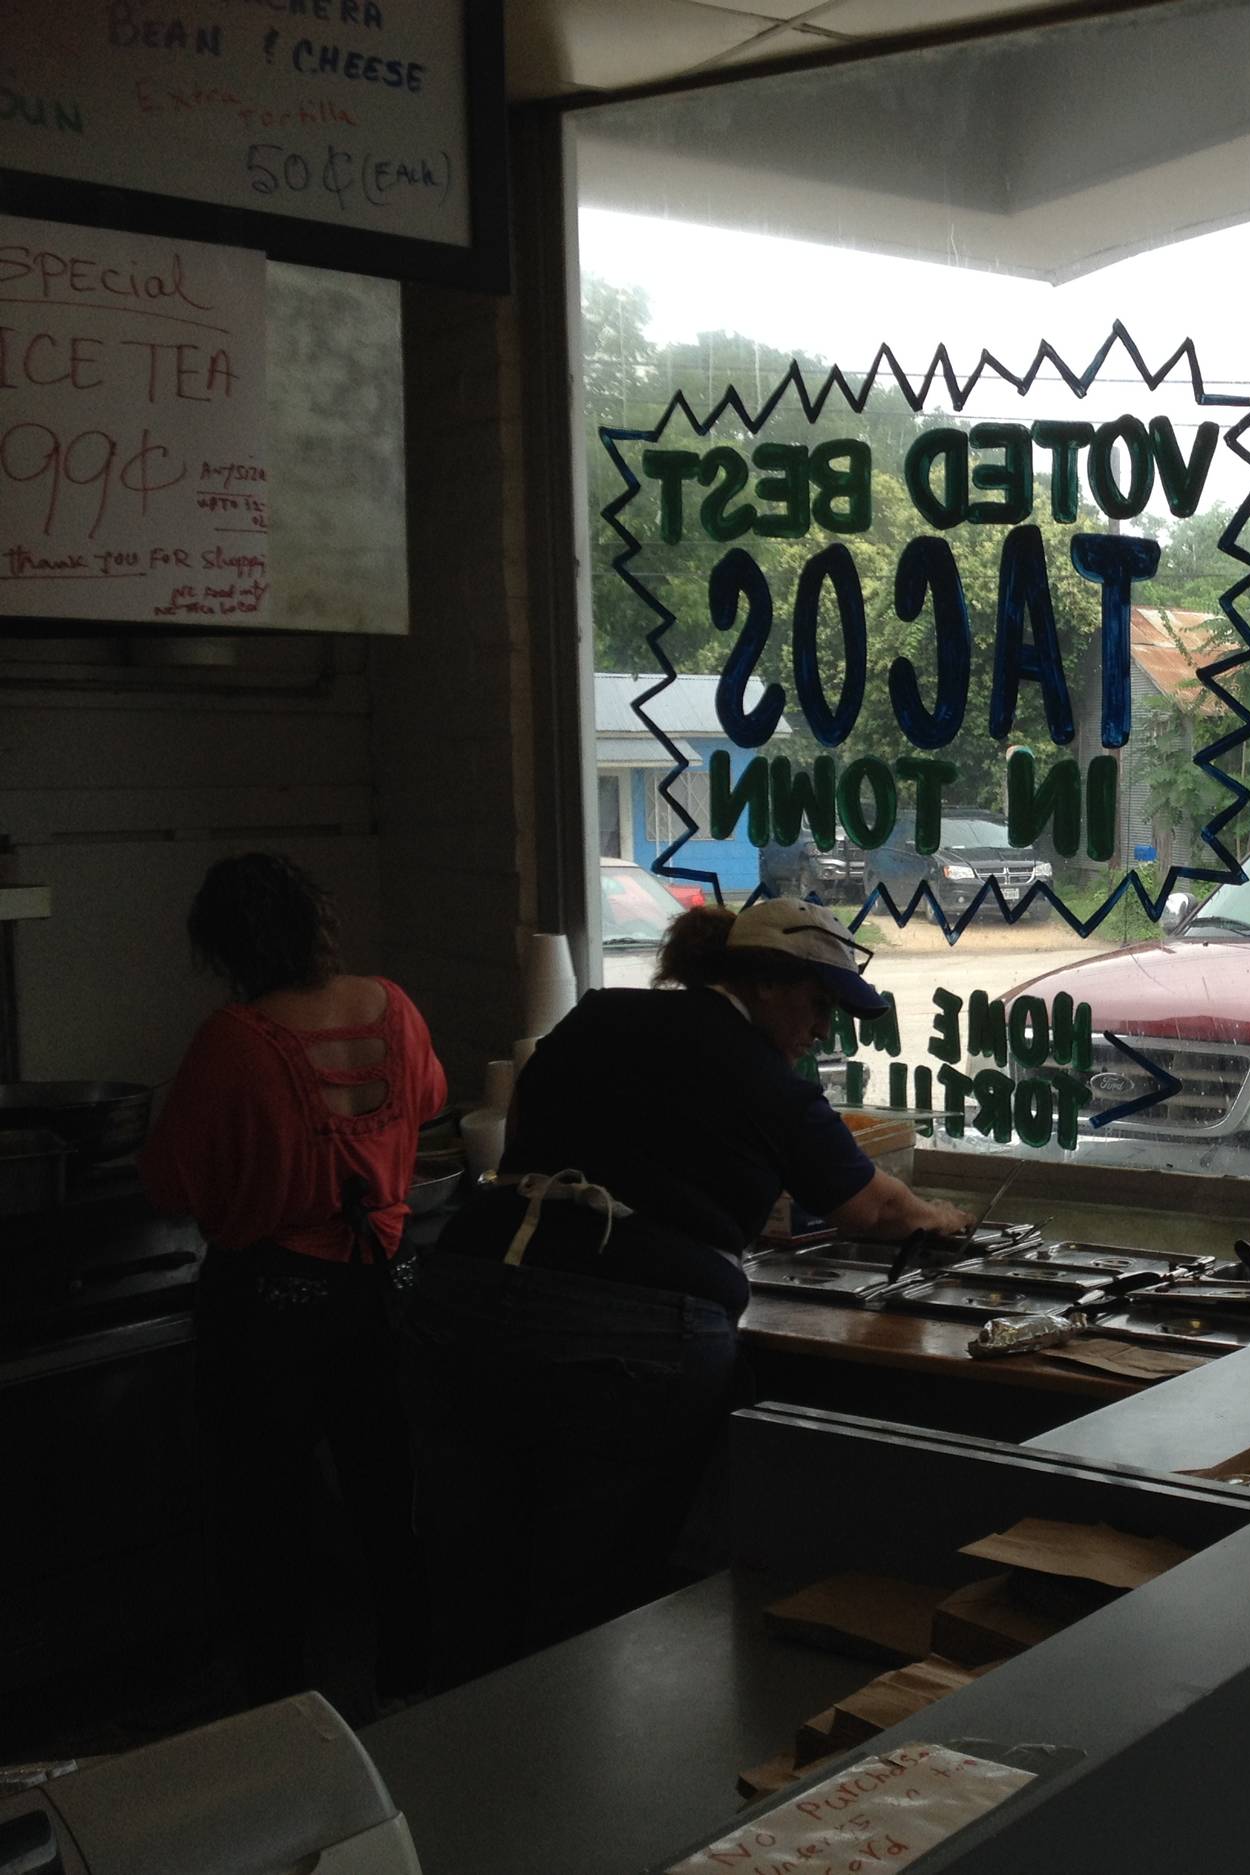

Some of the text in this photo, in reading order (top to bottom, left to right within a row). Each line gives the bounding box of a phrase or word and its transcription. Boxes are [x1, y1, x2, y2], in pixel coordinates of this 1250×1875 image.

[292, 38, 426, 93] CHEESE
[0, 326, 240, 402] ICE TEA
